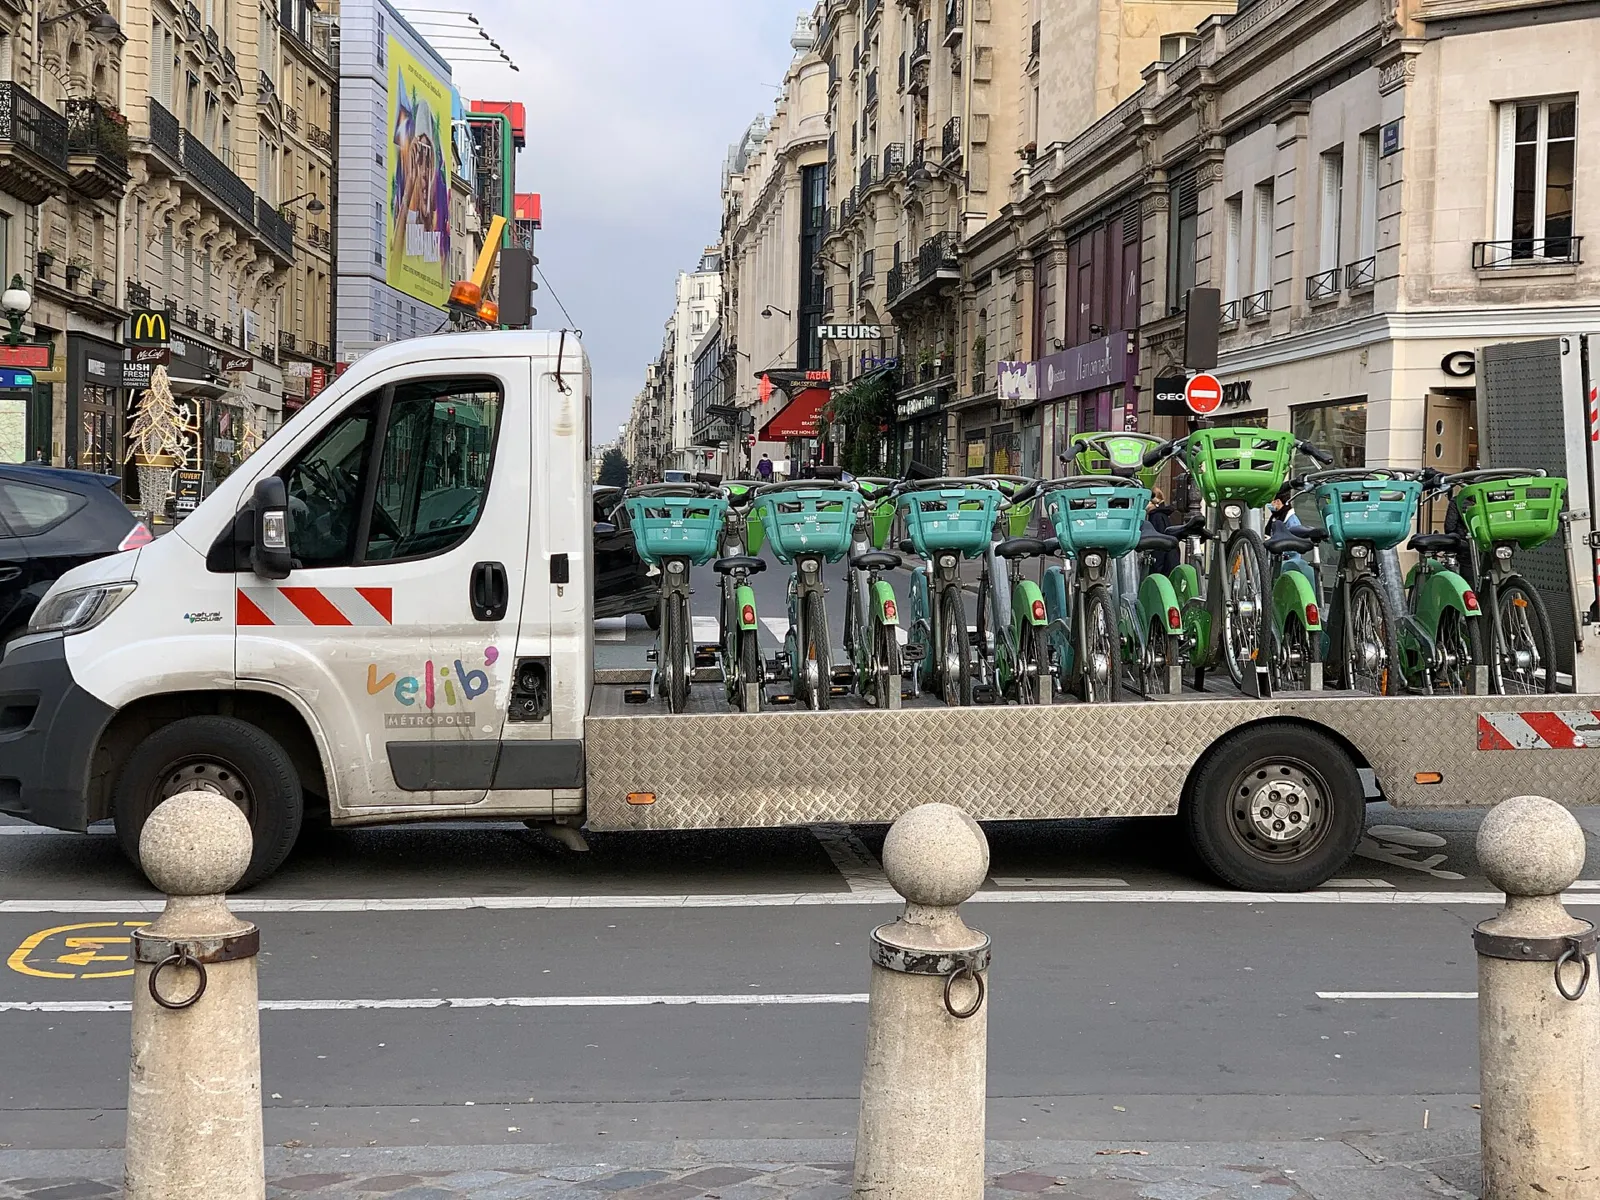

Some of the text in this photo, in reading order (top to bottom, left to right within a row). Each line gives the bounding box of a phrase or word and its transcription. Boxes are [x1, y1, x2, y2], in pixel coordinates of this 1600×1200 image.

[817, 325, 880, 339] FLEURS
[123, 363, 149, 371] LUSH
[123, 370, 149, 378] FRESH
[806, 371, 831, 382] TABA
[1156, 393, 1185, 401] GEO
[180, 472, 201, 480] OUVERT
[388, 714, 471, 726] MÉTROPOLE
